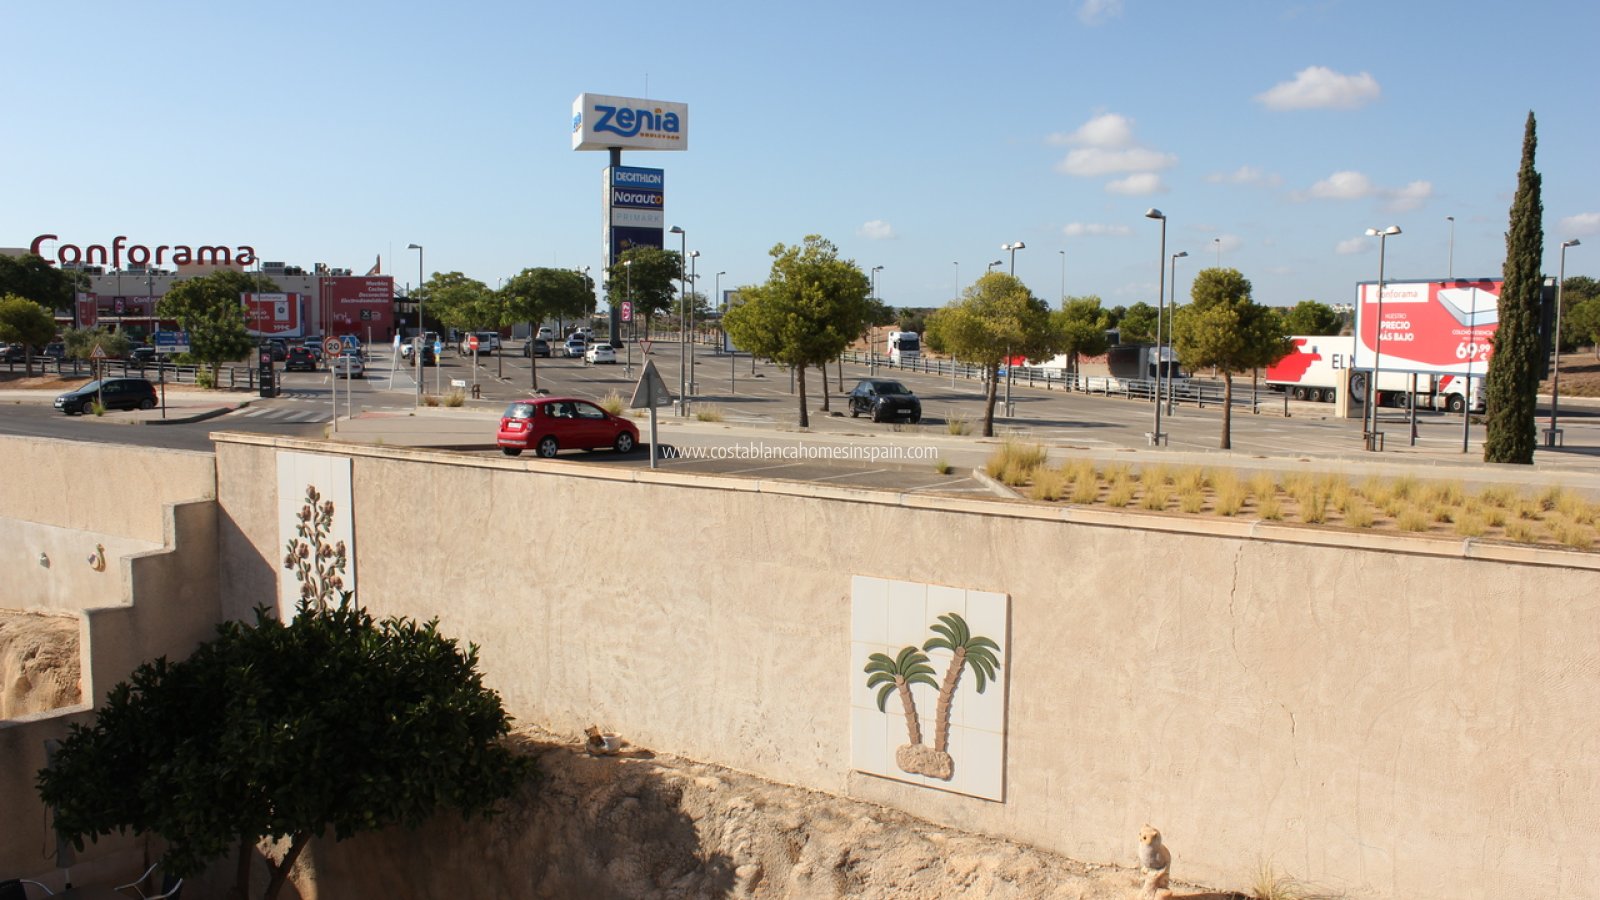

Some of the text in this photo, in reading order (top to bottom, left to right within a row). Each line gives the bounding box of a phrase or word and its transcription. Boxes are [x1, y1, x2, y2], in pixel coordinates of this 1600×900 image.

[615, 172, 661, 183] DECATHLON
[614, 191, 662, 204] Norauto
[30, 234, 255, 268] Conforama
[1380, 321, 1411, 330] PRECIO
[1394, 333, 1414, 341] BAJO
[328, 342, 340, 351] 20
